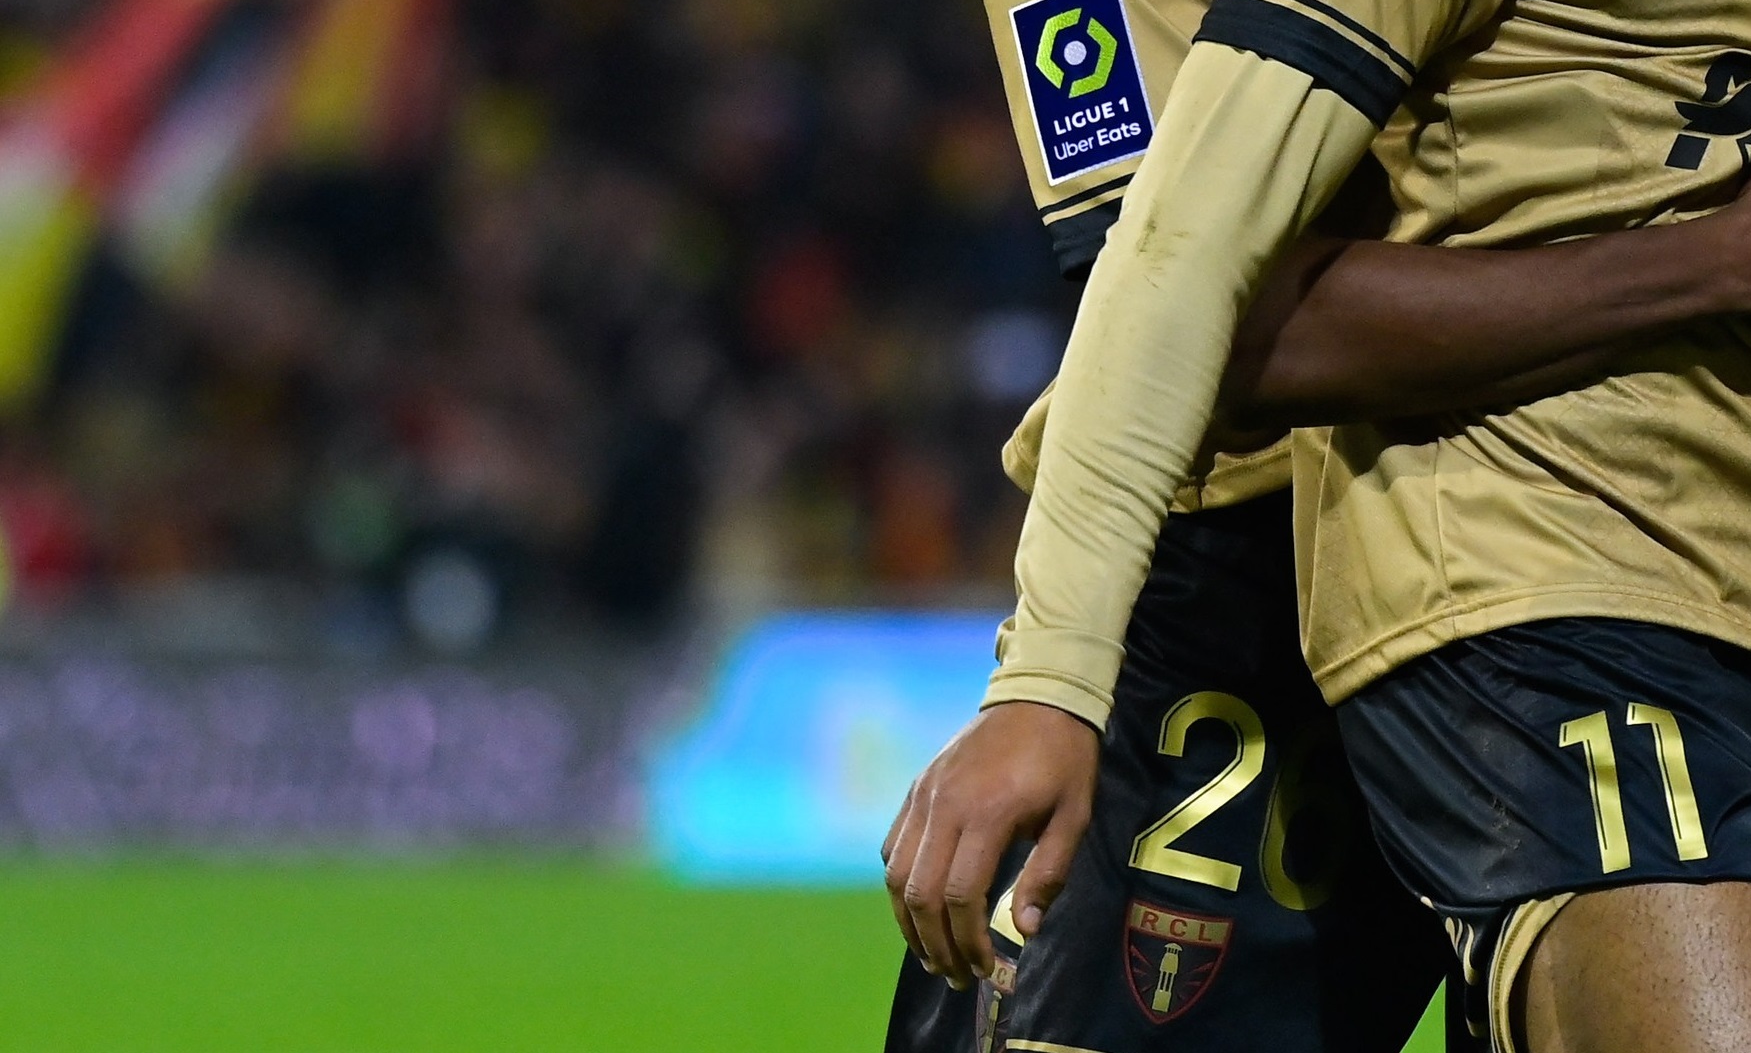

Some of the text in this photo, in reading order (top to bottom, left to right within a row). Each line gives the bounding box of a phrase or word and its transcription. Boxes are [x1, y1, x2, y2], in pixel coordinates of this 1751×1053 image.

[1053, 96, 1130, 136] LIGUE 1
[1053, 122, 1142, 161] Uber Eats
[1558, 701, 1709, 875] 11
[1140, 910, 1212, 942] RCL
